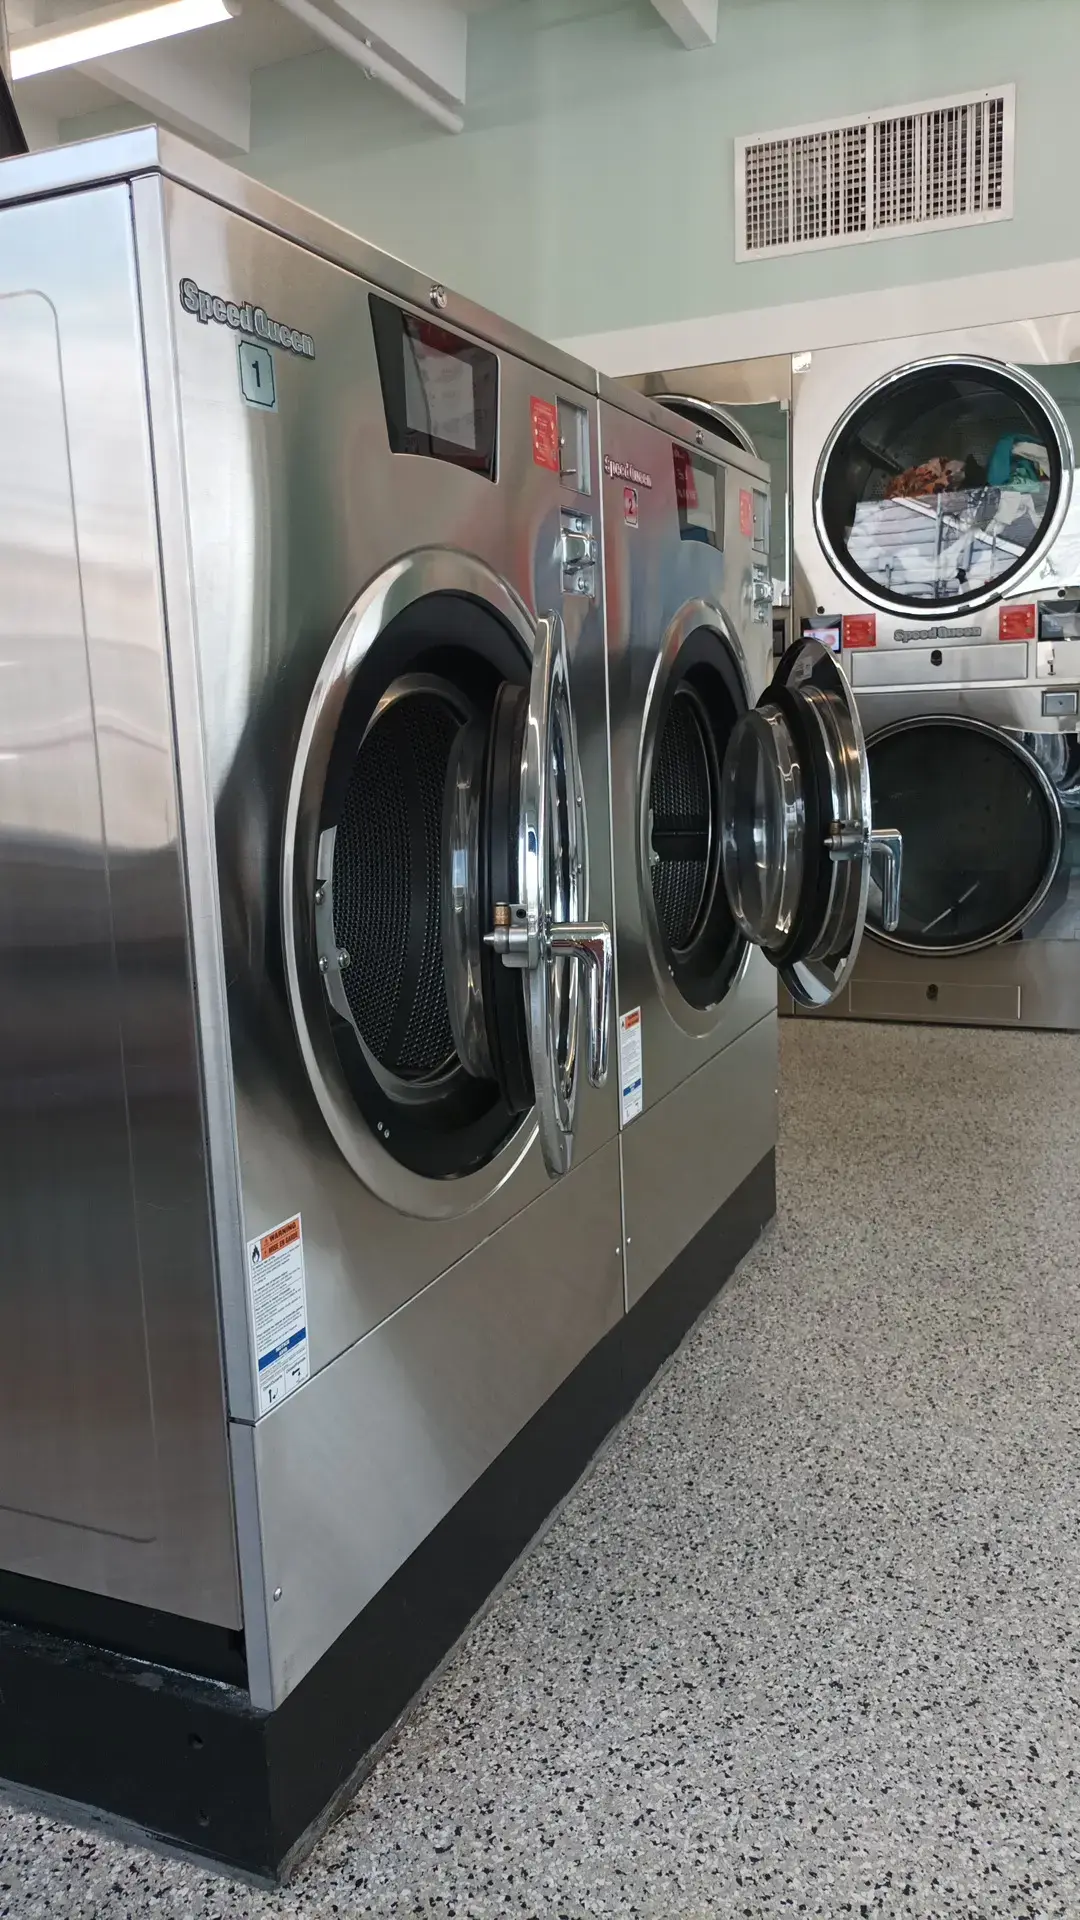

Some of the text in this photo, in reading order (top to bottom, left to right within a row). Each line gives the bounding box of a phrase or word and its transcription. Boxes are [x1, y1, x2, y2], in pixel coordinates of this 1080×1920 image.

[179, 278, 315, 360] Speed Queen
[252, 360, 260, 387] 1
[604, 454, 629, 480] Speed
[629, 498, 634, 514] 2
[894, 626, 981, 643] Speed Queen
[269, 1221, 297, 1242] WARNING
